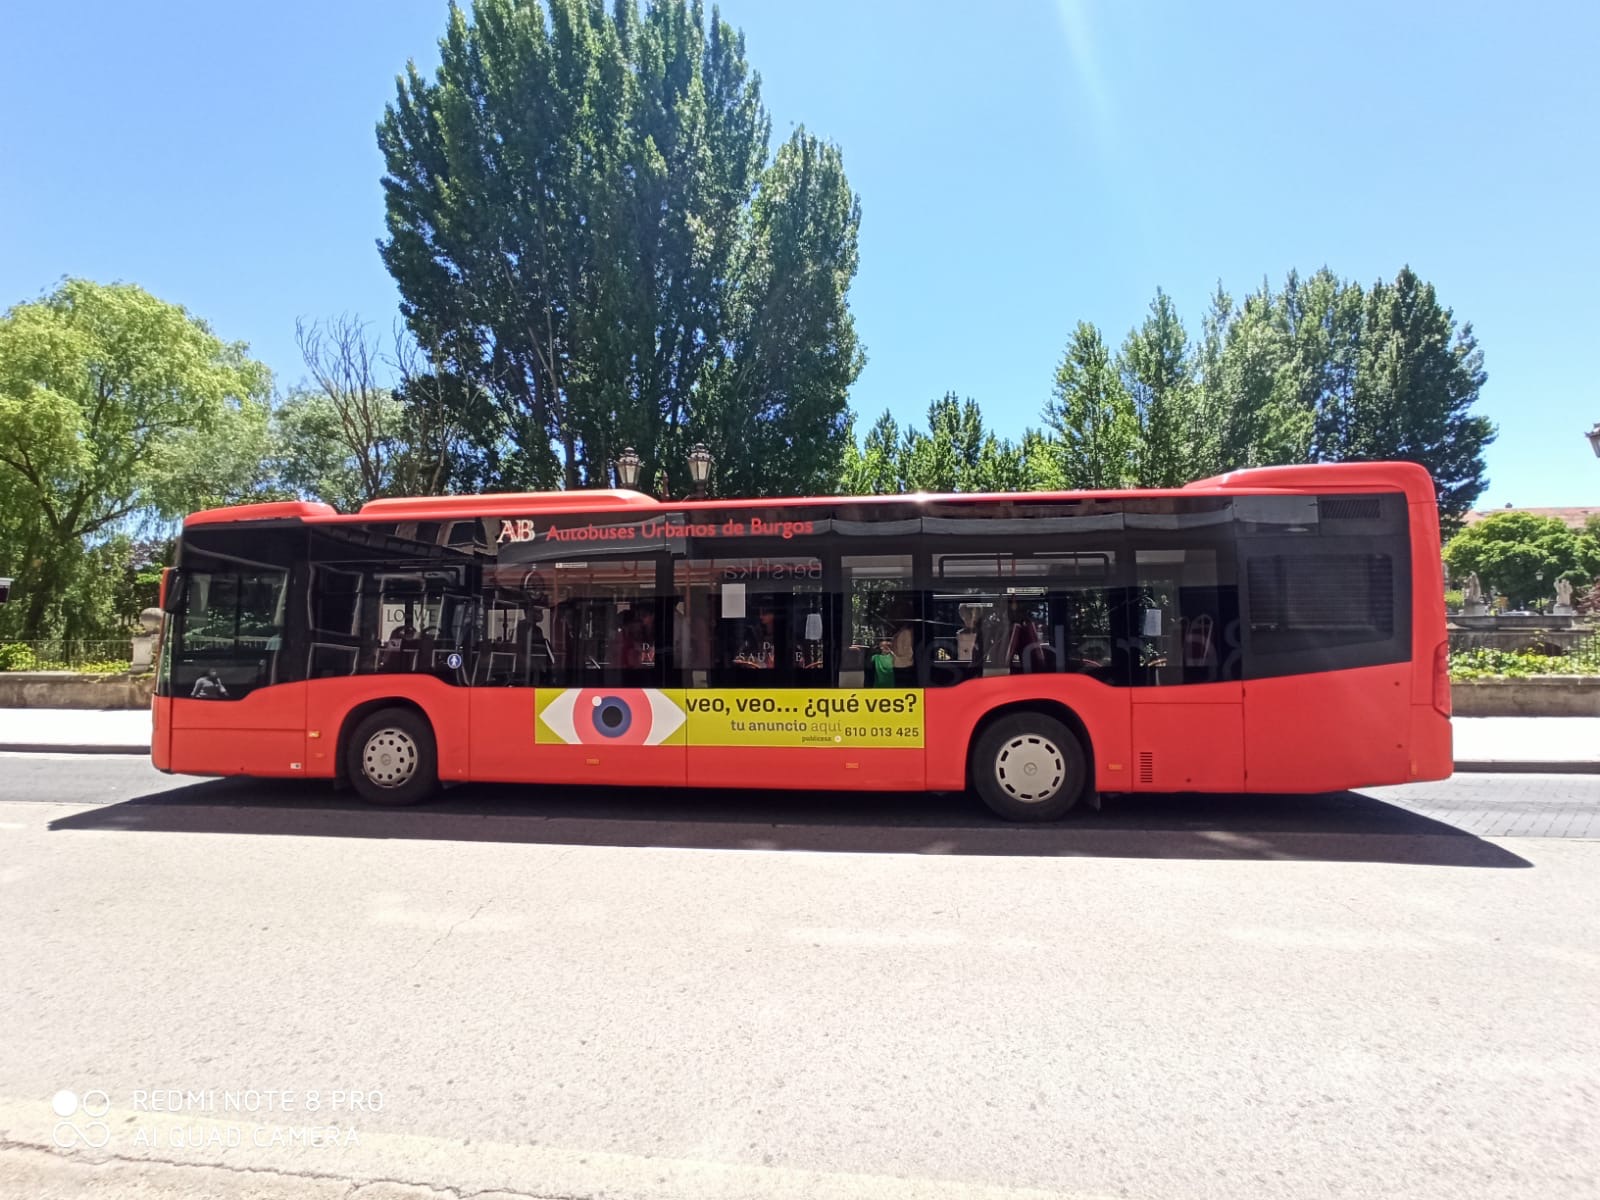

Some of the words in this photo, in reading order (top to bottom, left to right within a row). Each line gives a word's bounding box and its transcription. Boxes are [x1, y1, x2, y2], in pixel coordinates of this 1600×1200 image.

[545, 523, 635, 541] Autobuses
[641, 521, 716, 538] Urbanos
[722, 518, 744, 535] de
[751, 517, 814, 539] Burgos
[386, 608, 437, 623] LOWE
[686, 698, 731, 716] veo,
[736, 698, 798, 713] veo...
[804, 694, 859, 718] ¿qué
[865, 693, 917, 713] ves?
[731, 719, 745, 732] tu
[748, 719, 807, 732] anuncio
[811, 719, 842, 735] aquí
[844, 727, 866, 737] 610
[870, 727, 892, 737] 013
[896, 727, 919, 738] 425
